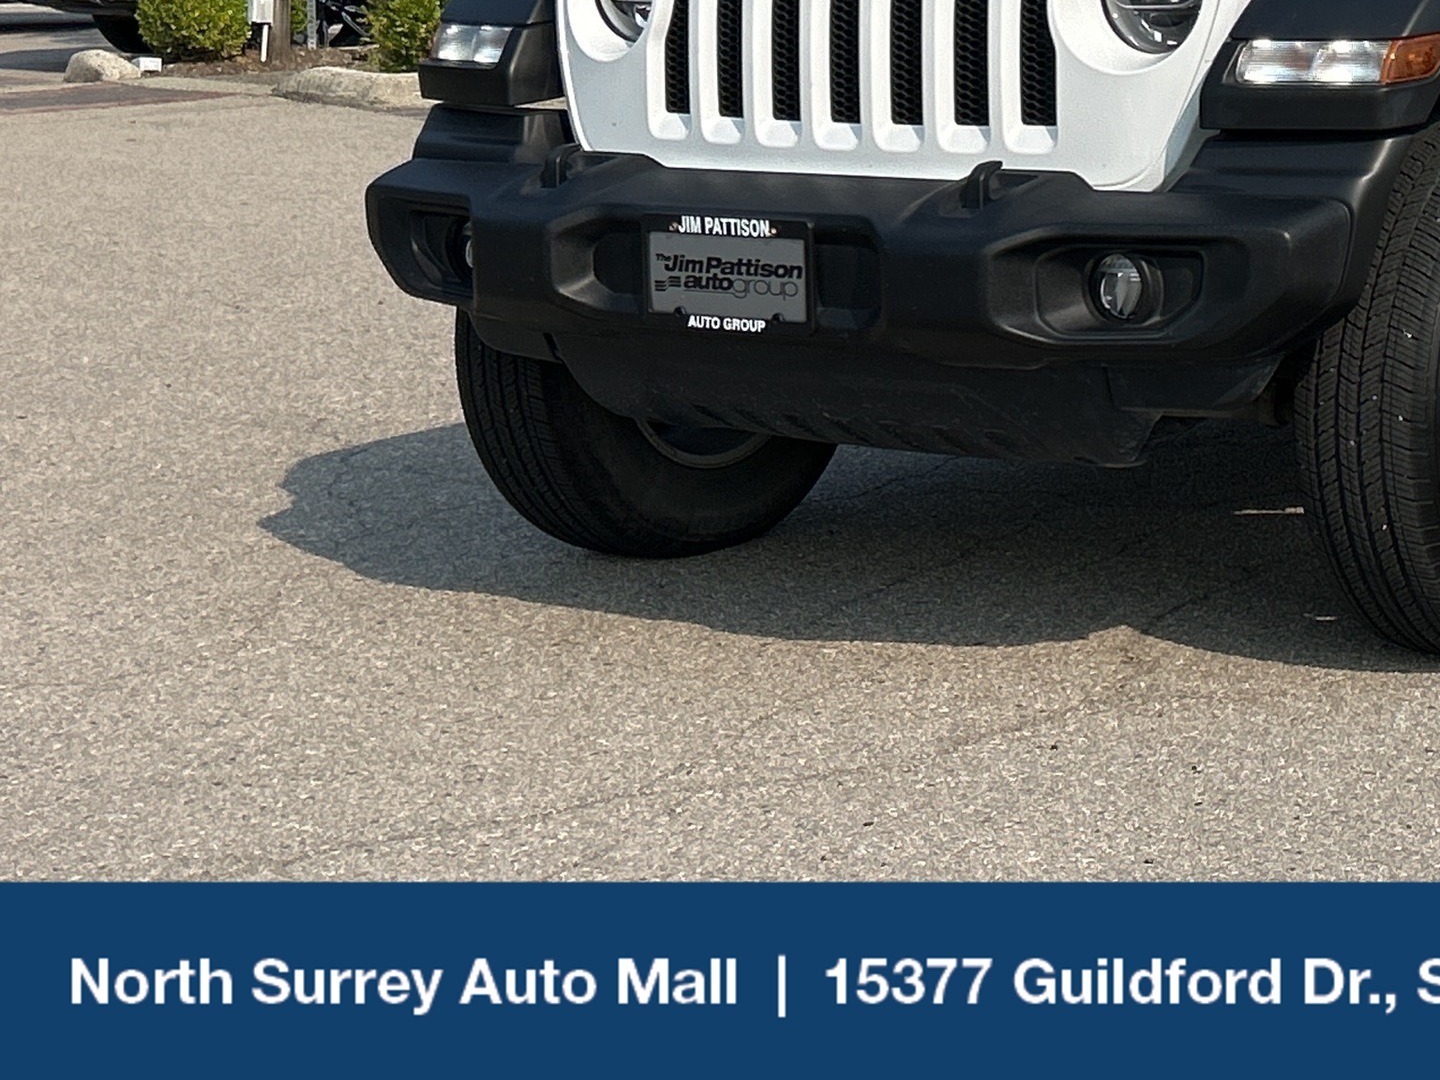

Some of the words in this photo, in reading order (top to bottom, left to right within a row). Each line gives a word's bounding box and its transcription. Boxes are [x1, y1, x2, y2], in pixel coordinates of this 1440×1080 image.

[677, 215, 702, 235] JIM
[703, 217, 770, 238] PATTISON
[664, 254, 704, 275] Jim
[705, 256, 803, 280] Pattison
[687, 315, 721, 330] AUTO
[722, 317, 767, 333] GROUP
